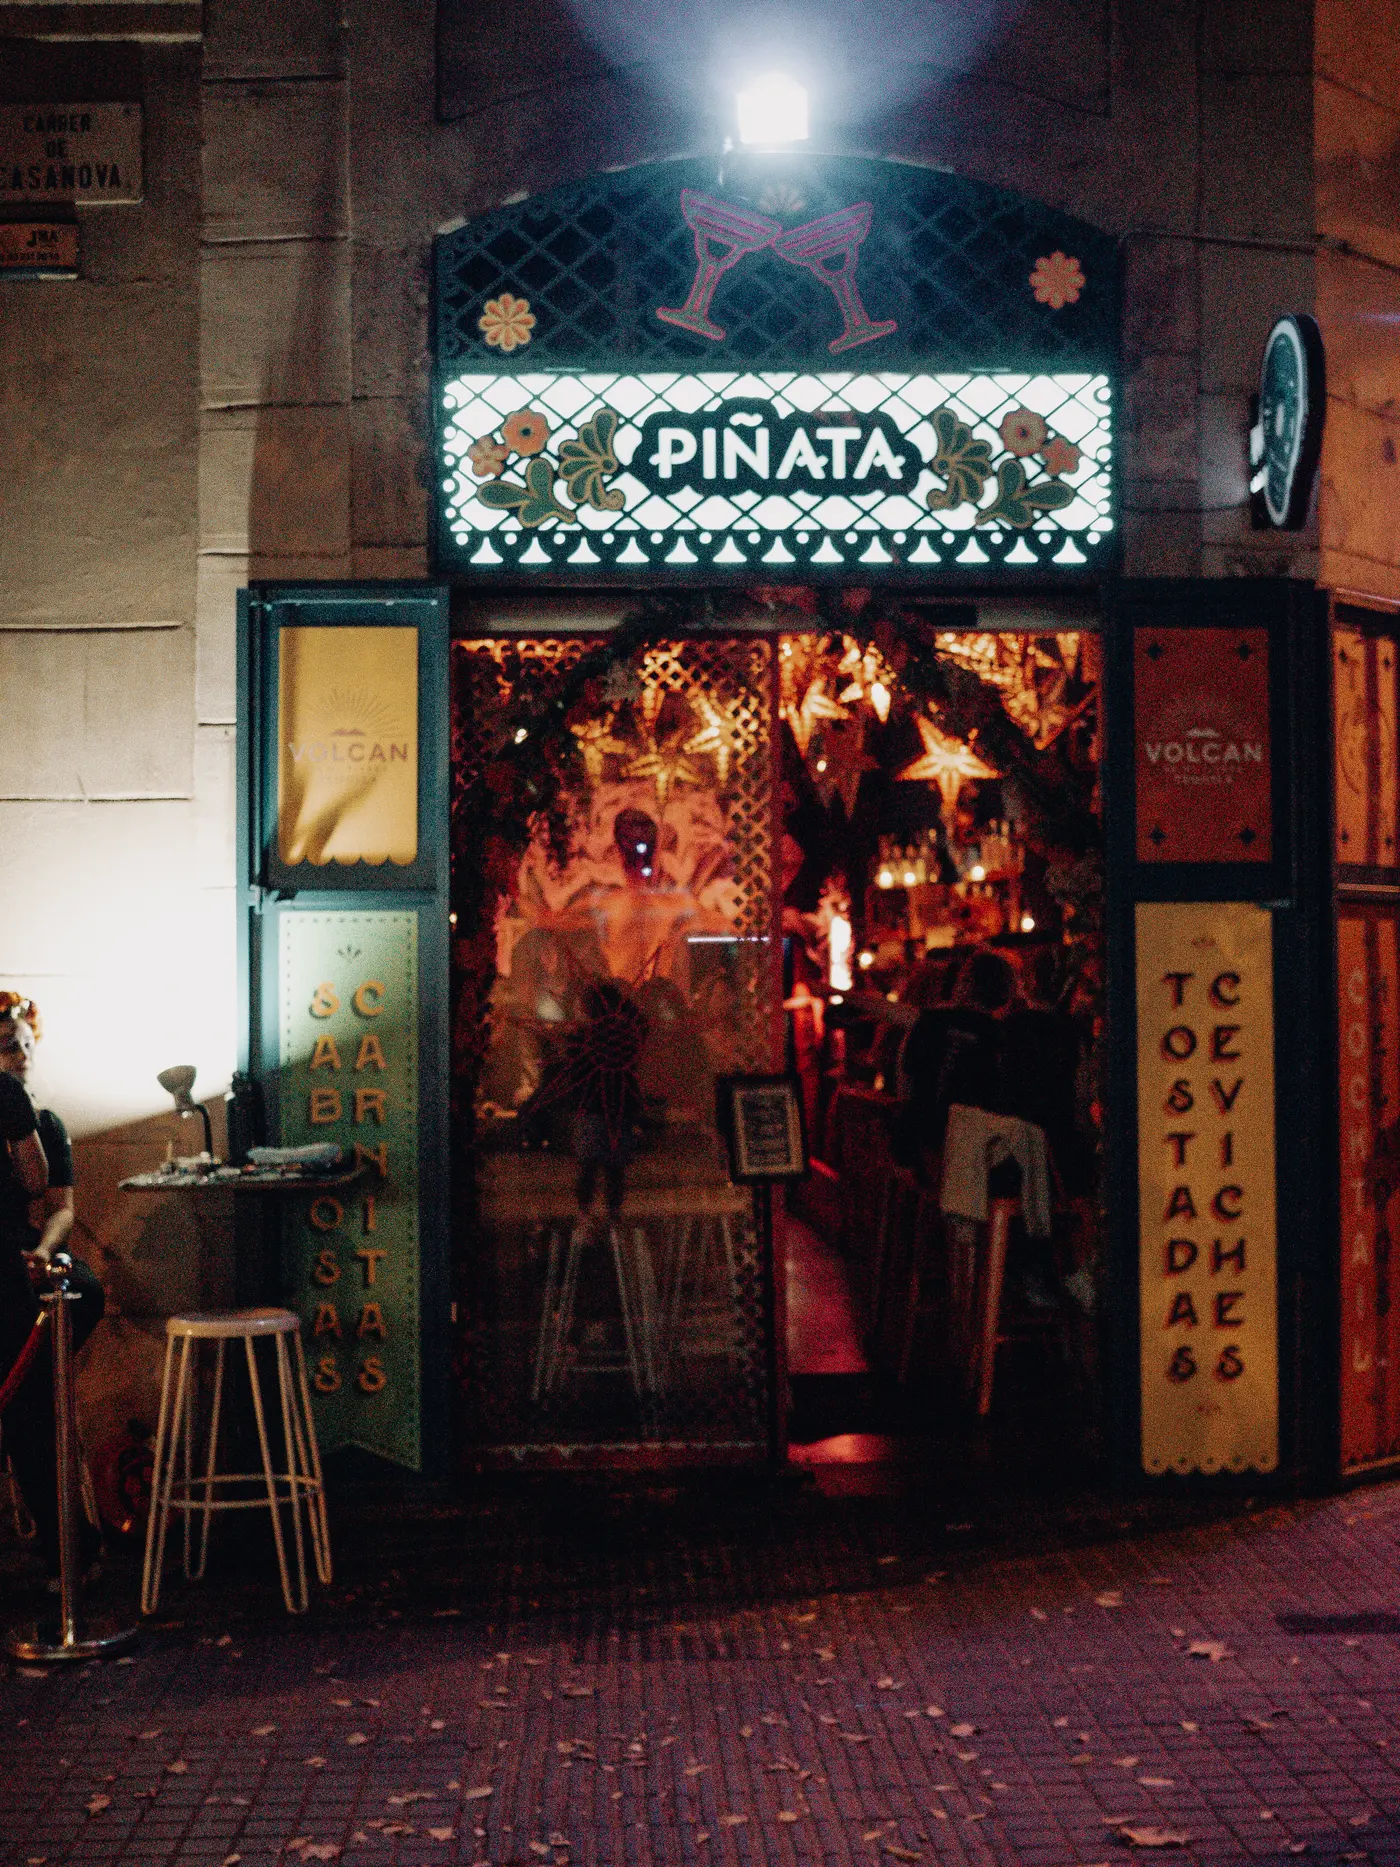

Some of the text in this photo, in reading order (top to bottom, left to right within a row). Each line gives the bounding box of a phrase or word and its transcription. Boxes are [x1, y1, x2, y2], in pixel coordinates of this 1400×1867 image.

[23, 113, 91, 132] CARRER
[45, 138, 67, 159] DE
[648, 411, 905, 480] PIÑATA
[287, 741, 408, 764] VOLCAN
[1144, 741, 1263, 765] VOLCAN
[309, 981, 344, 1392] SABOSAS
[353, 981, 388, 1392] CARNITAS
[1160, 971, 1198, 1382] TOSTADAS
[1210, 971, 1246, 1382] CEVICHES
